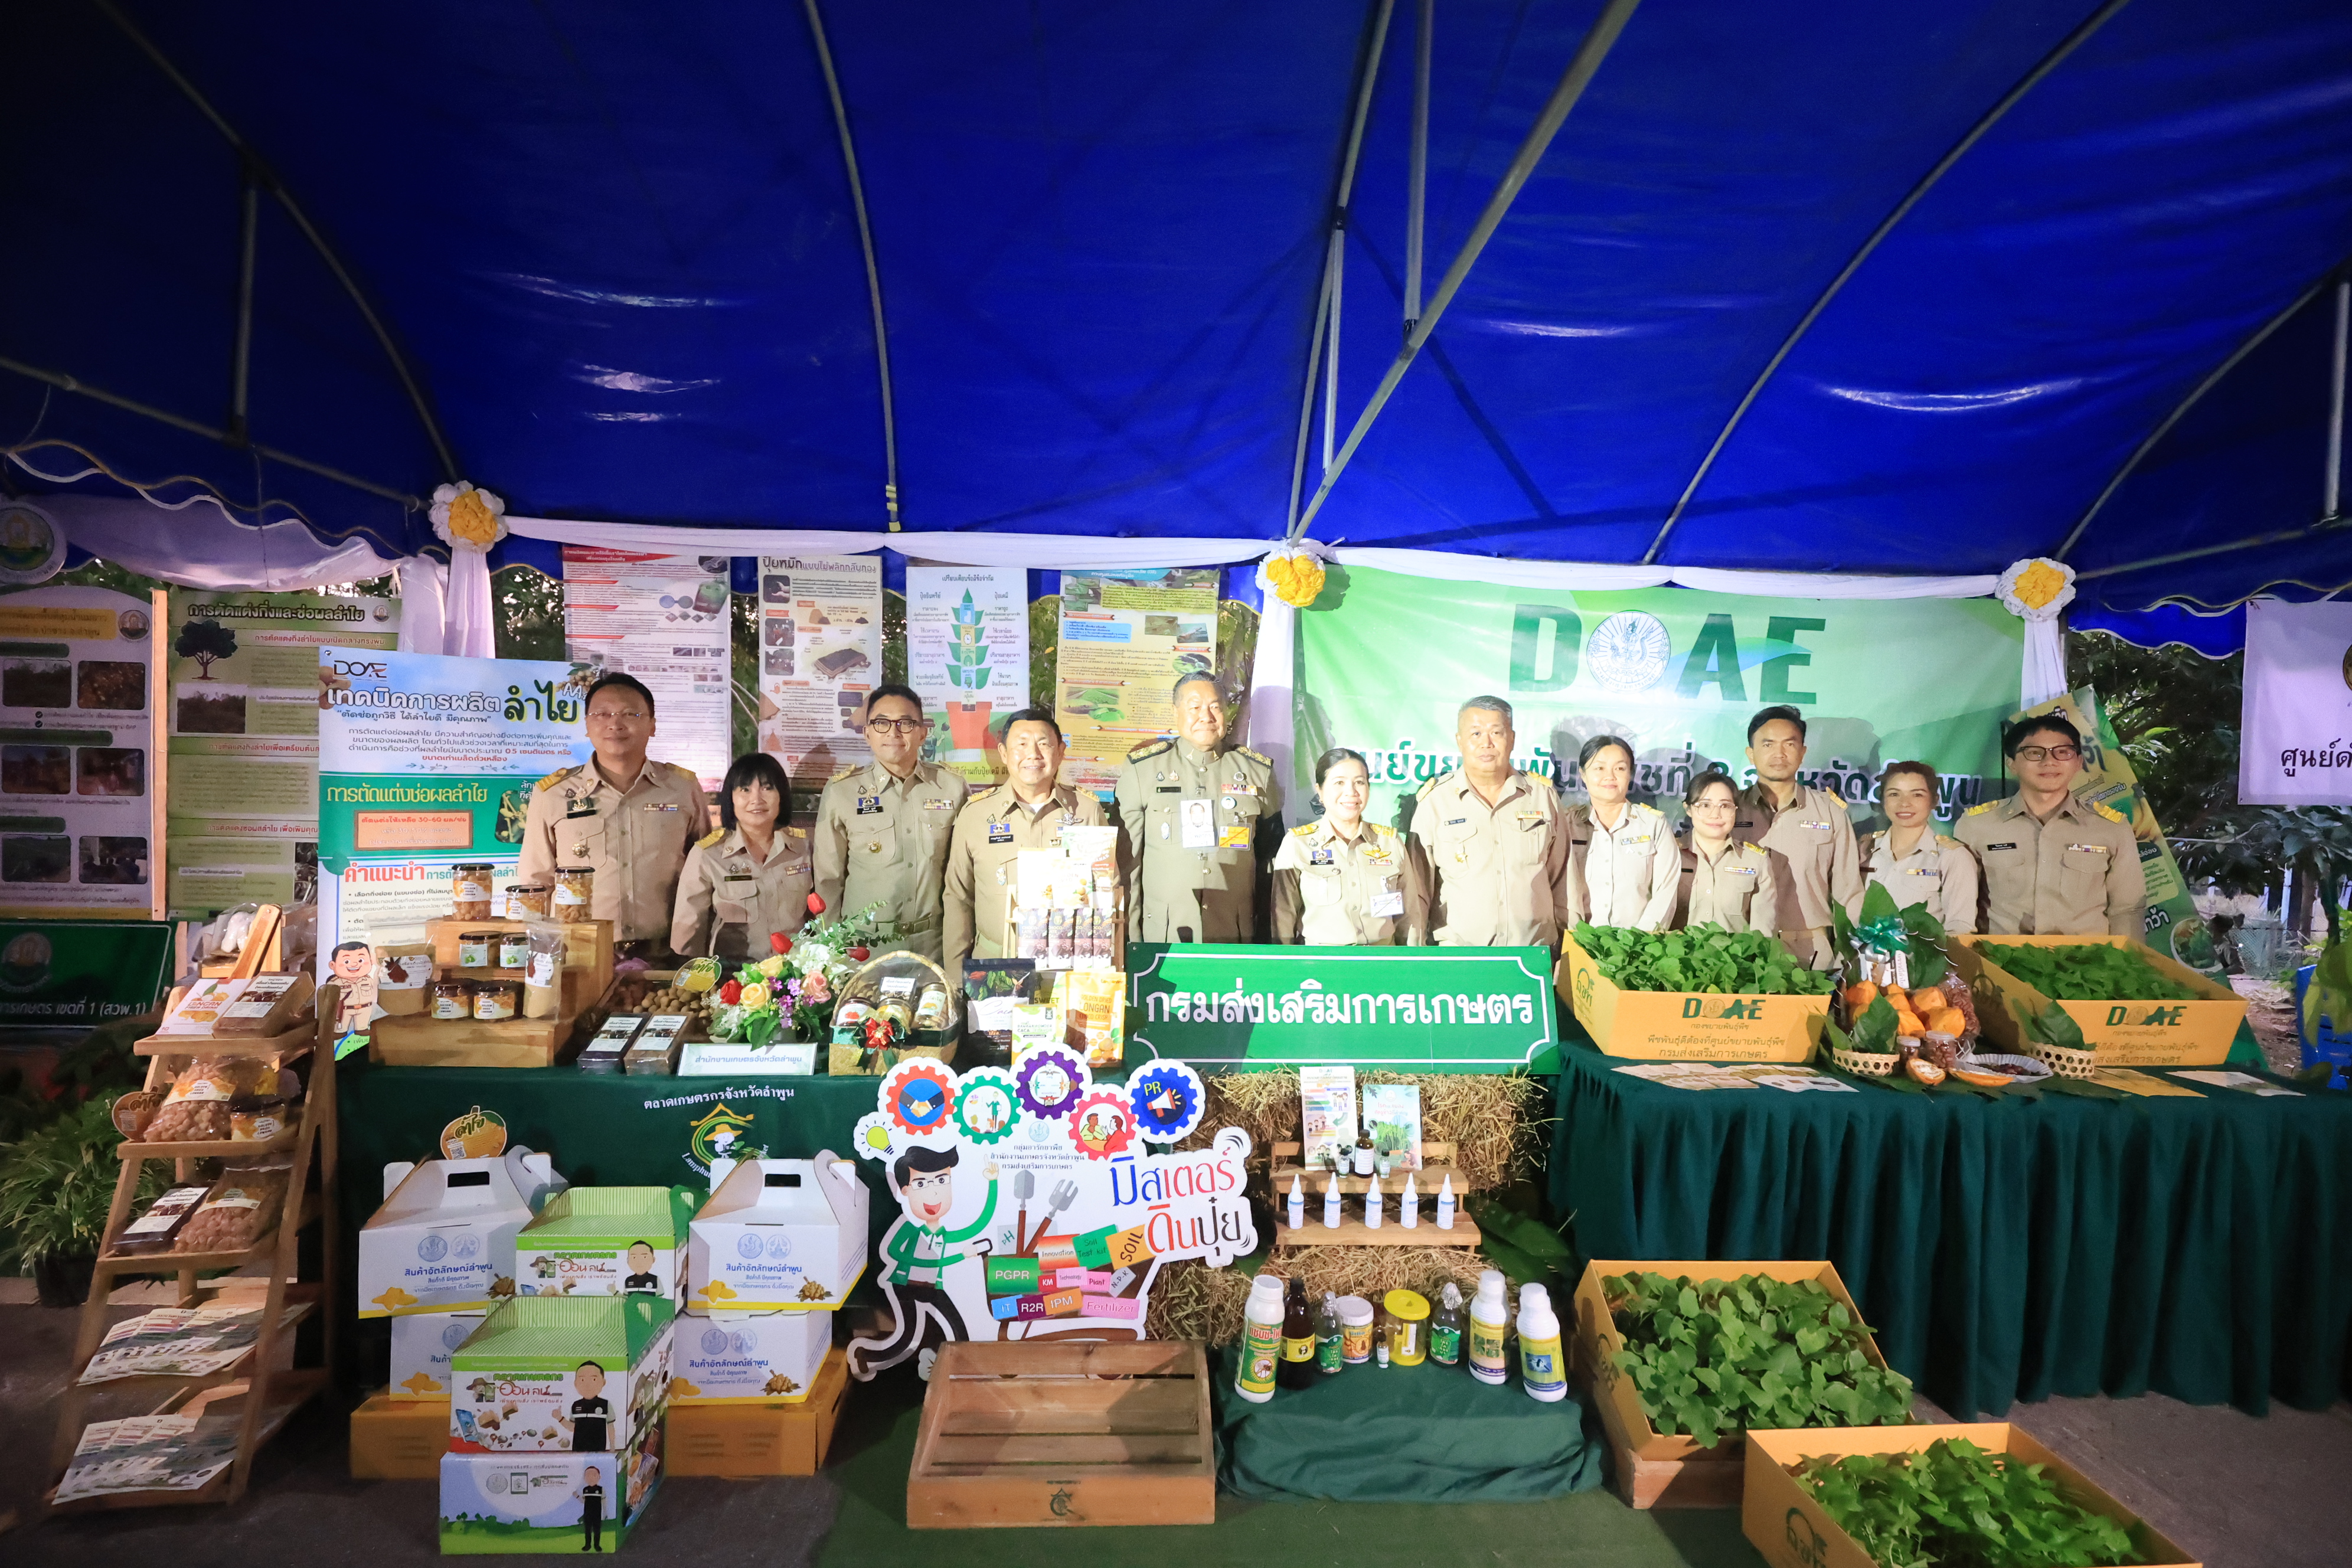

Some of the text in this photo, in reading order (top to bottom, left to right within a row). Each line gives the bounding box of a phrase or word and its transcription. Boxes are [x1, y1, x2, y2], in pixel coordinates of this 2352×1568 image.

[188, 600, 365, 621] การตัดแต่งกิ่งและช่อผลลำไย
[504, 679, 578, 723] ลำไย
[348, 727, 432, 737] การตัดแต่งช่อผลลำไย
[352, 736, 419, 744] ขนาดของผลผลิต
[326, 783, 488, 802] การตัดแต่งช่อผลลำไย
[345, 861, 424, 883] คำแนะนำ
[1146, 977, 1533, 1025] กรมส่งเสริมการเกษตร
[1079, 1002, 1110, 1014] LONGAN
[1690, 1023, 1749, 1031] กองขยายพันธุ์พืช
[1647, 1033, 1785, 1047] พืชพันธุ์ดีต้องที่ศูนย์ขยายพันธุ์พืช
[1659, 1046, 1768, 1059] กรมส่งเสริมการเกษตร
[695, 1054, 802, 1064] สำนักงานเกษตรจังหวัดลำพูน
[1144, 1081, 1162, 1096] PR
[643, 1084, 795, 1110] ตลาดเกษตรกรจังหวัดลำพูน
[454, 1112, 485, 1139] ลำไย
[1014, 1144, 1063, 1152] กลุ่มอารักขาพืช
[991, 1152, 1085, 1162] สำนักงานเกษตรจังหวัดลำพูน
[1002, 1162, 1073, 1170] กรมส่งเสริมการเกษตร
[1109, 1146, 1235, 1207] มิสเตอร์
[1147, 1196, 1241, 1256] ดินปุ๋ย
[1084, 1239, 1098, 1247] Soil
[1120, 1232, 1144, 1263] SOIL
[1041, 1249, 1074, 1257] Innovation
[1078, 1246, 1106, 1259] Test kit
[404, 1262, 493, 1277] สินค้าอัตลักษณ์ลำพูน
[726, 1263, 802, 1275] สินค้าอัตลักษณ์ลำพูน
[995, 1270, 1030, 1280] PGPR
[1042, 1278, 1053, 1286] KM
[1001, 1304, 1010, 1312] IT
[1021, 1302, 1044, 1312] R2R
[1050, 1295, 1073, 1309] IPM
[1086, 1301, 1135, 1313] Fertilizer
[689, 1358, 769, 1369] สินค้าอัตลักษณ์ลำพูน
